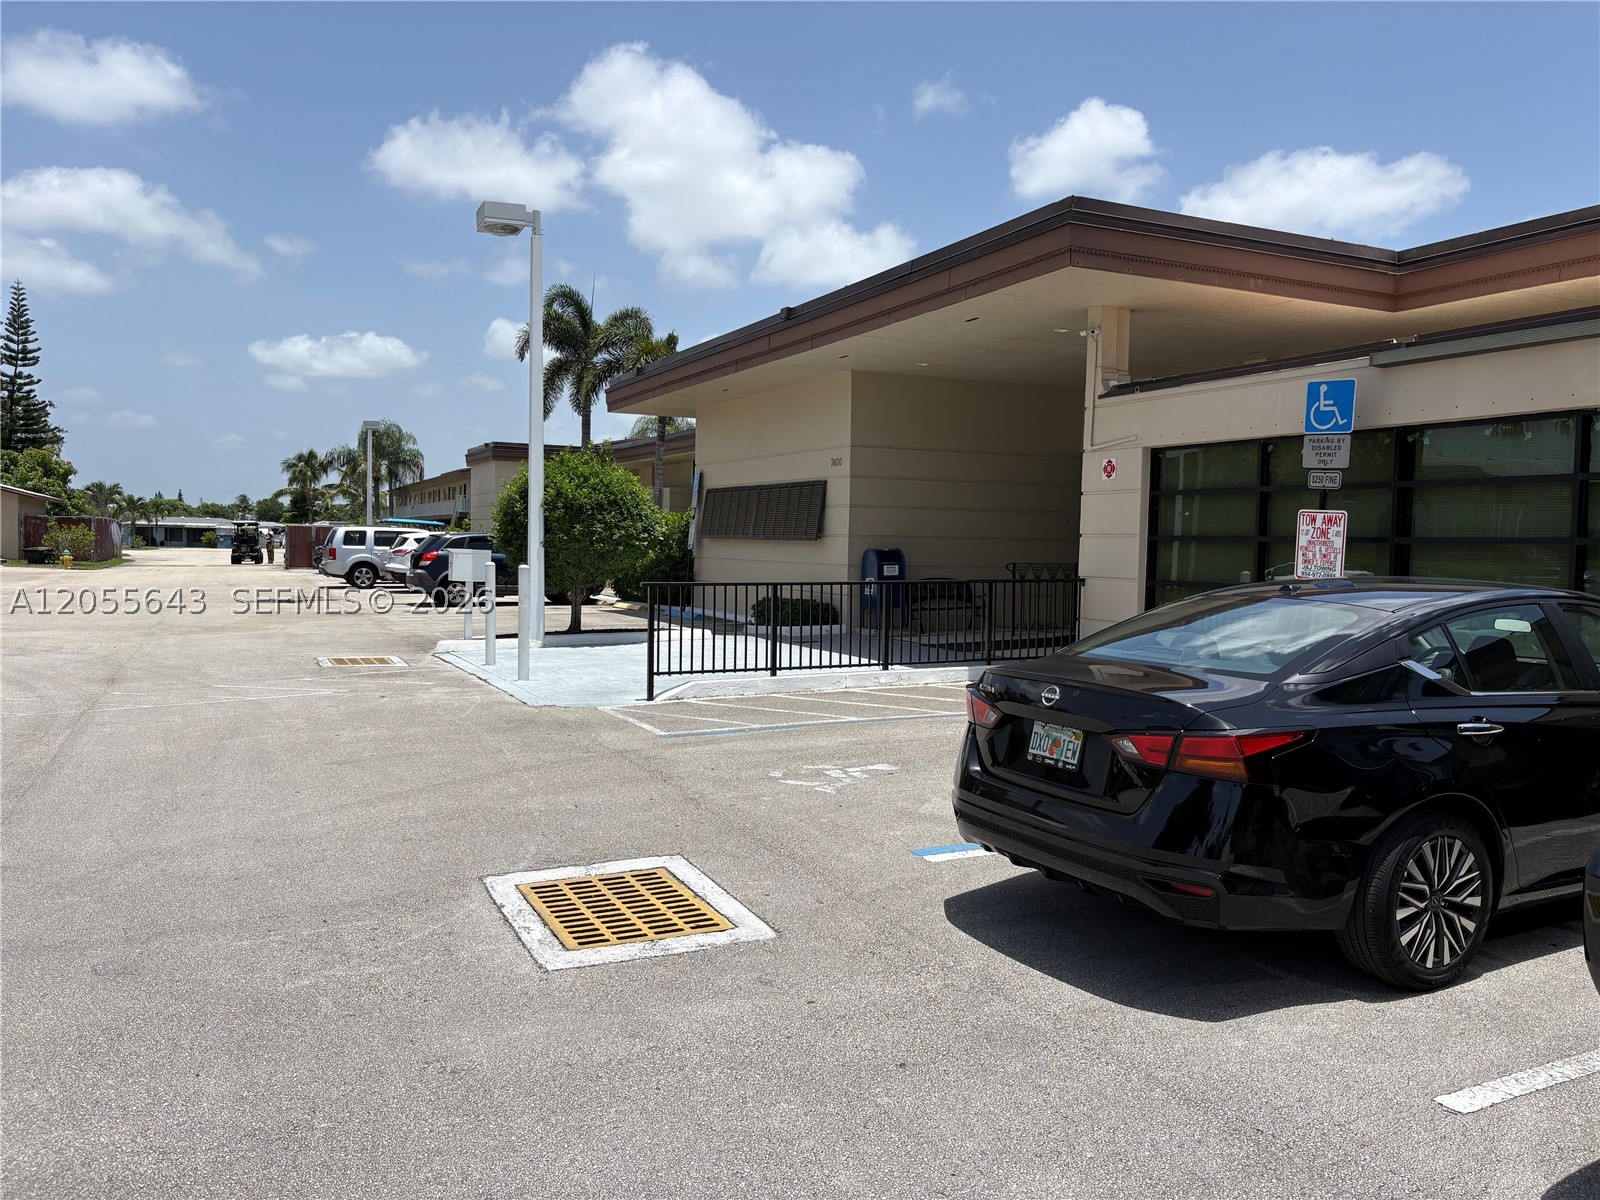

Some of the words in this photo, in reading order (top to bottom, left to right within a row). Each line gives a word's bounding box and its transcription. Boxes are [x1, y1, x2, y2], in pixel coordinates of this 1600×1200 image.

[1311, 475, 1324, 484] $250
[1325, 475, 1338, 484] FINE
[1301, 514, 1318, 527] TOW
[1321, 514, 1344, 528] AWAY
[1311, 527, 1331, 540] ZONE
[1041, 692, 1061, 700] NISSAN
